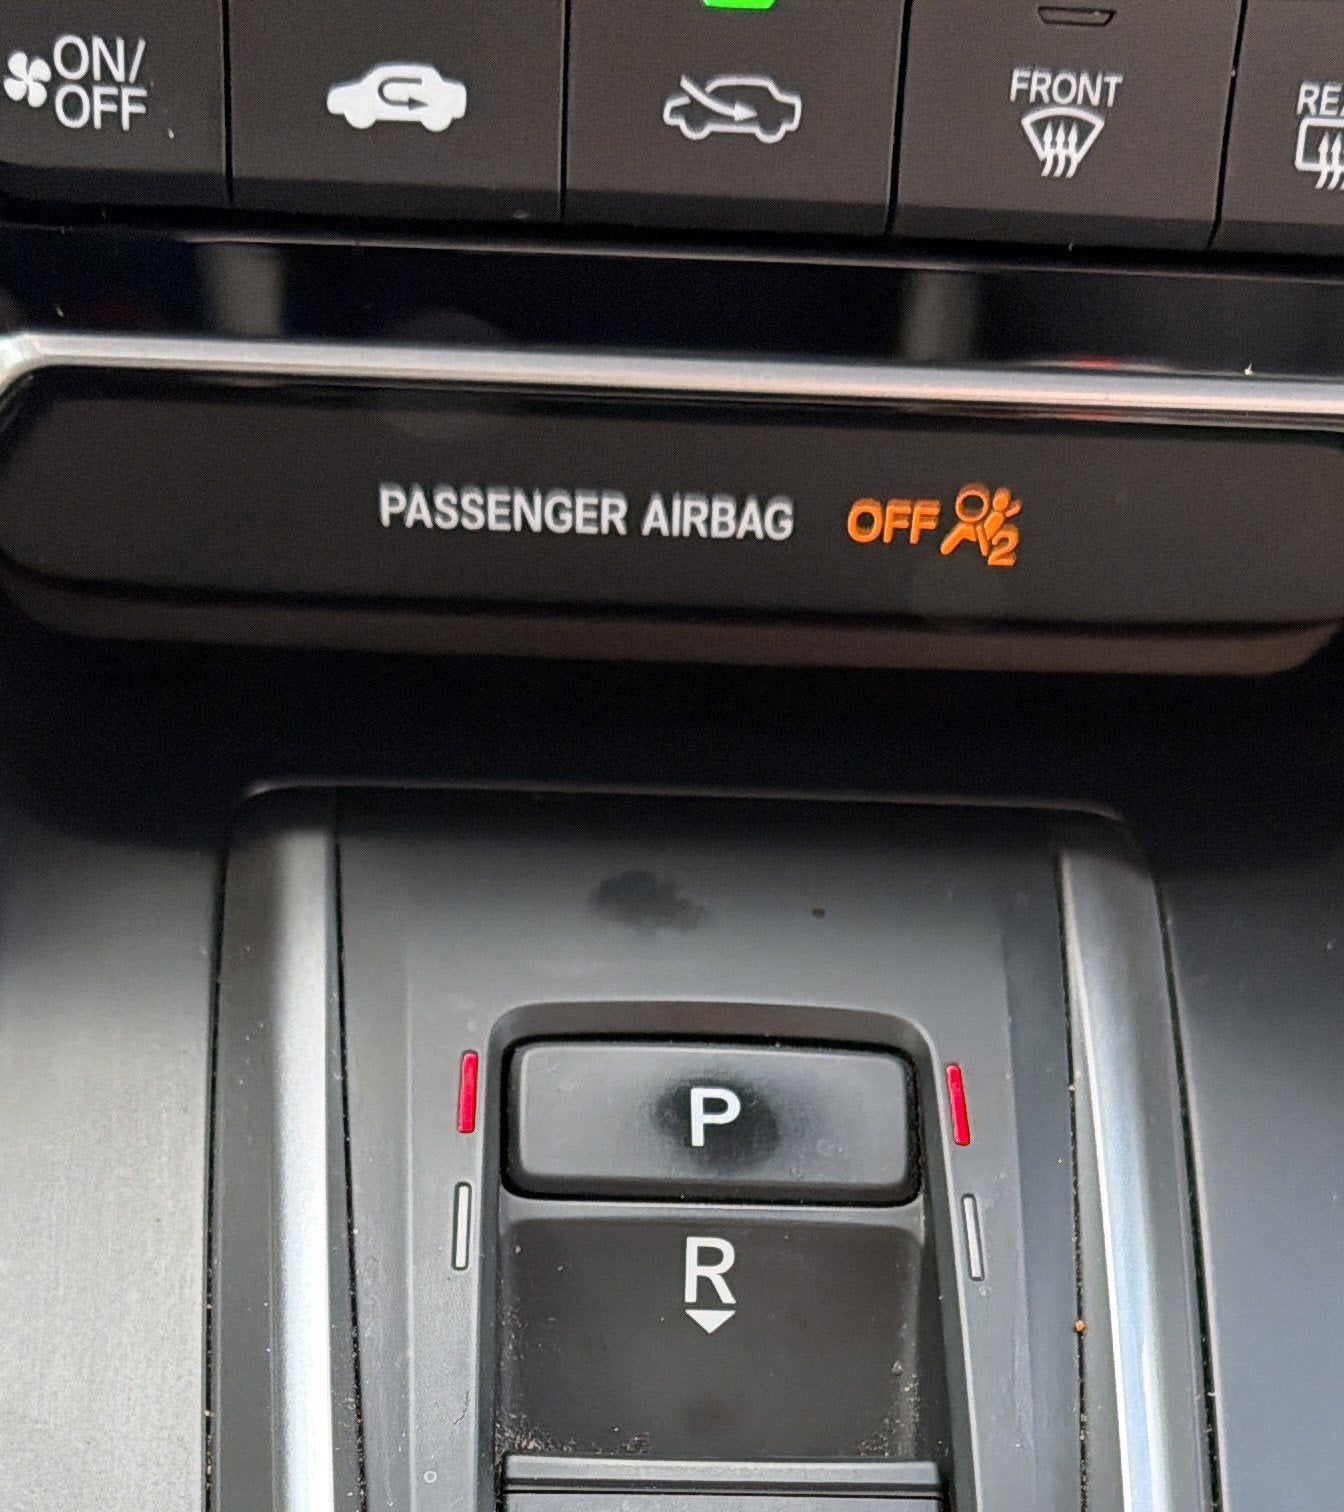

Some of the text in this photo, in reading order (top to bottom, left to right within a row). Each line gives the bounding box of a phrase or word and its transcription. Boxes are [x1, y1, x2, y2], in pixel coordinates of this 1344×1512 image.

[52, 34, 147, 84] ON/
[1010, 66, 1123, 107] FRONT
[53, 84, 149, 132] OFF
[378, 483, 942, 546] PASSENGER AIRBAG OFF
[687, 1086, 742, 1147] P
[682, 1236, 737, 1306] R
